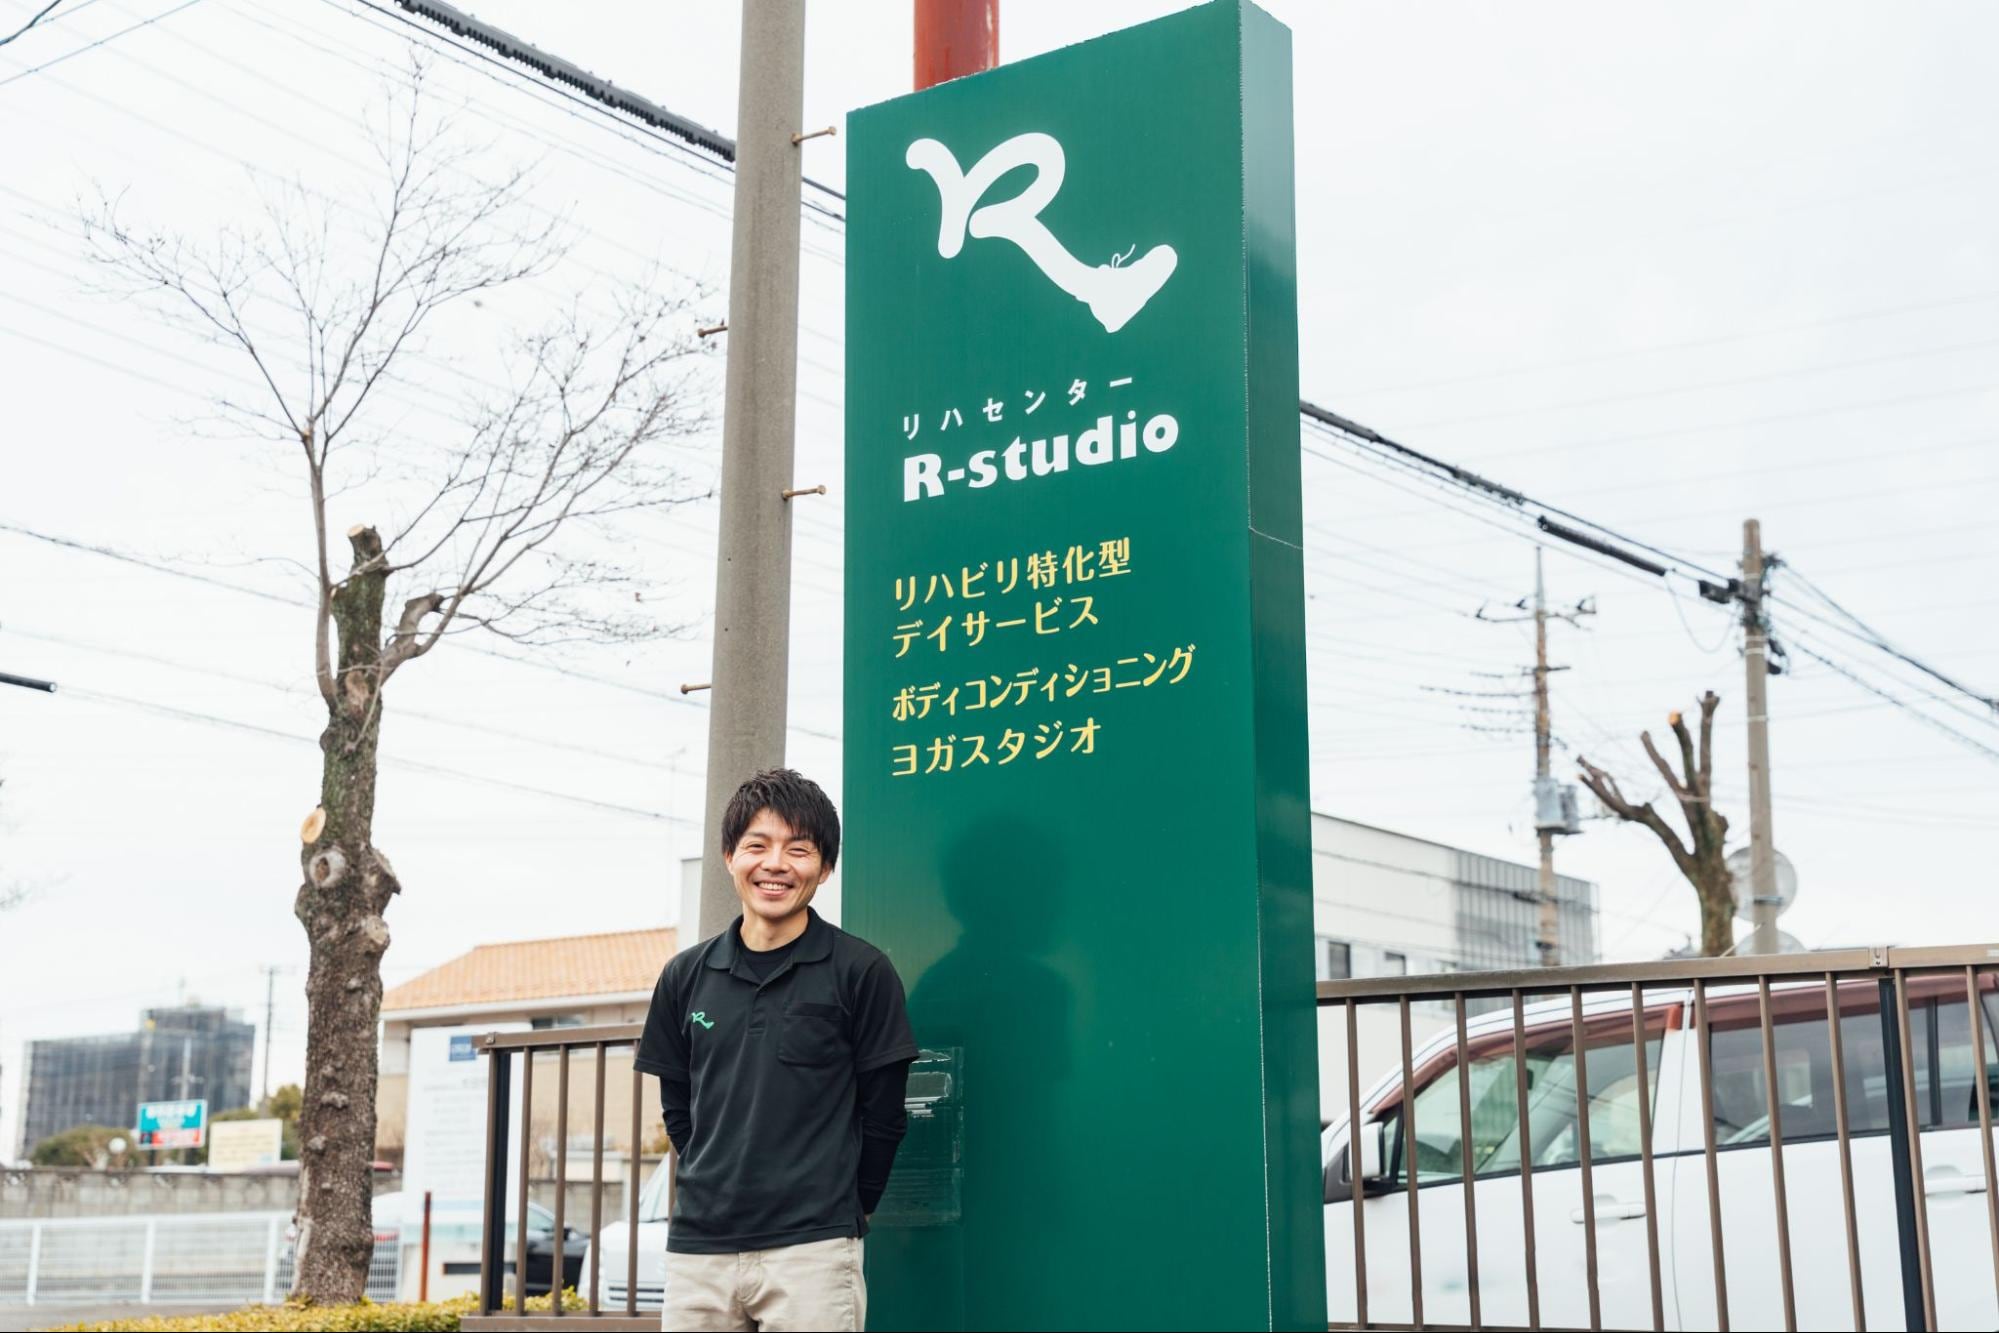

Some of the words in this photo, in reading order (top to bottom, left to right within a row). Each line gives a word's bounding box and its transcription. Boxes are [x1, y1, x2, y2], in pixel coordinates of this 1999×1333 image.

[903, 376, 1133, 441] リハセンター
[904, 409, 1179, 503] R-studio
[895, 536, 1131, 611] リハビリ特化型
[892, 596, 1099, 658] デイサービス
[892, 643, 1196, 722] ボディコンディショニング
[892, 717, 1102, 776] ヨガスタジオ
